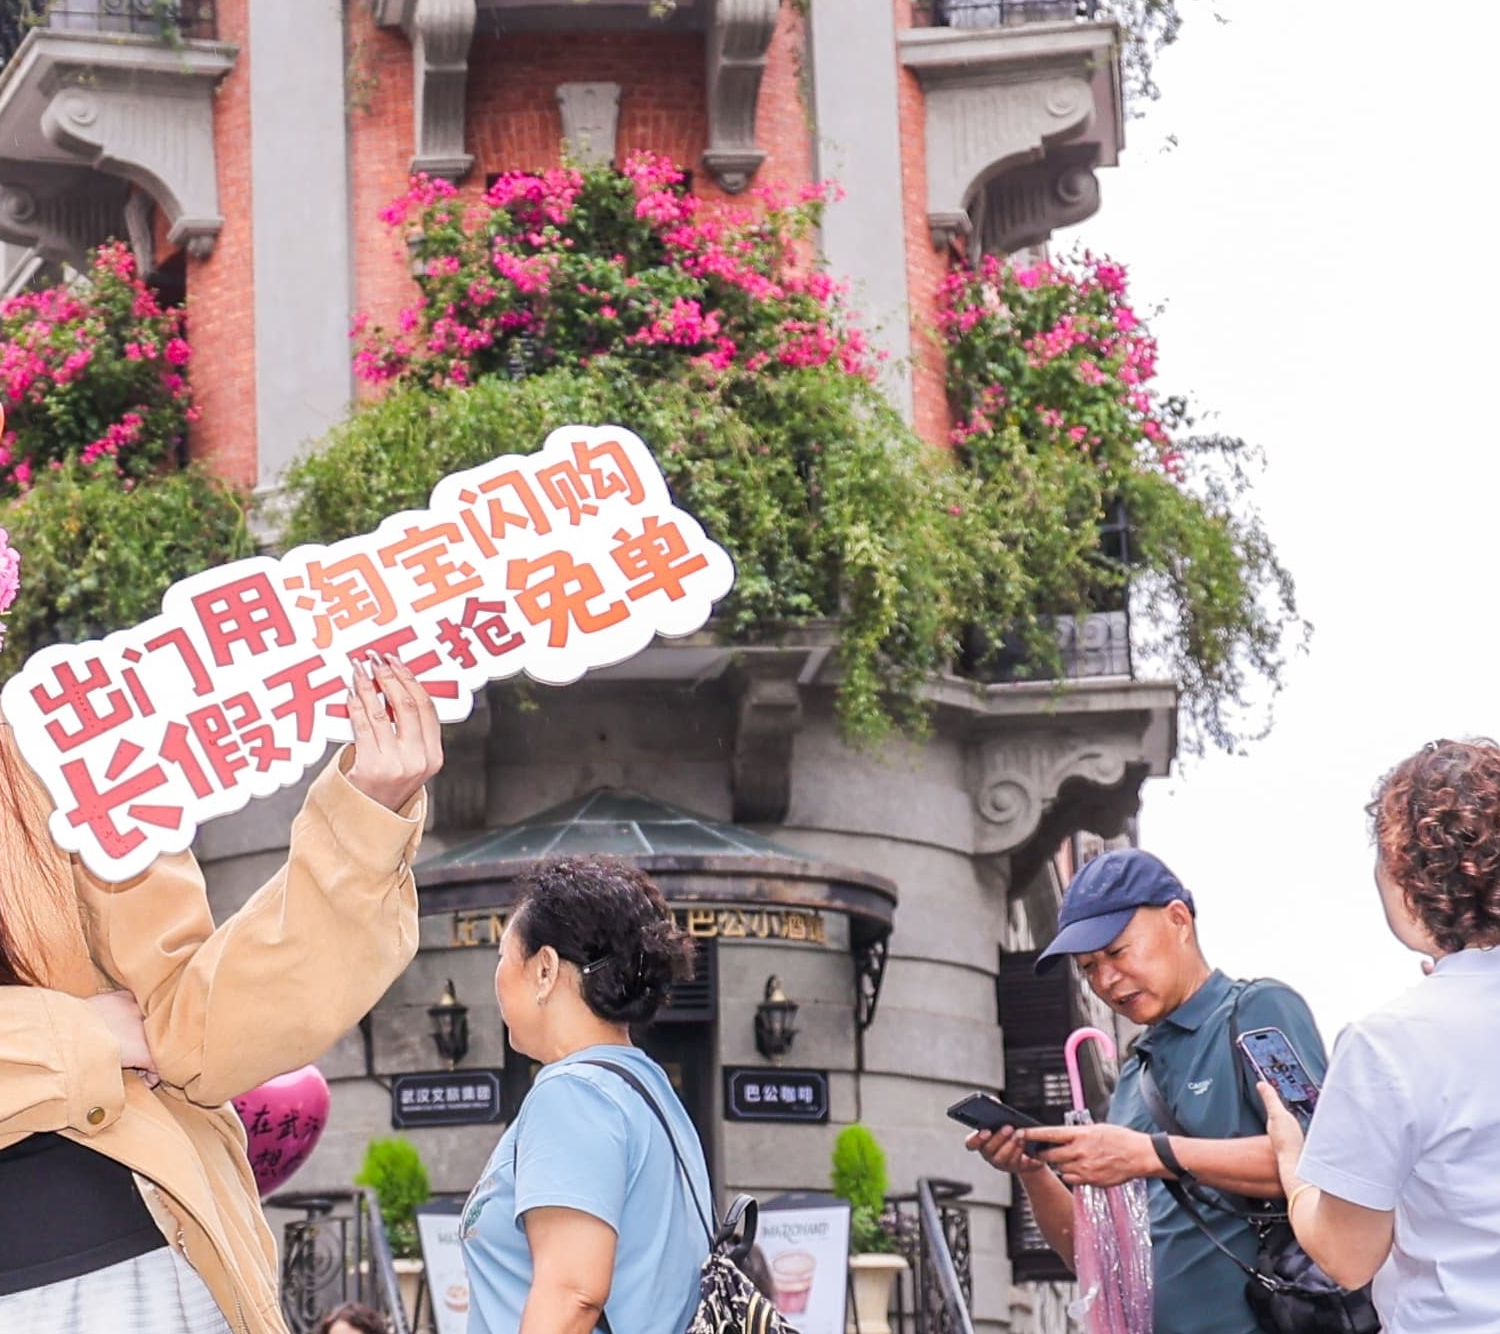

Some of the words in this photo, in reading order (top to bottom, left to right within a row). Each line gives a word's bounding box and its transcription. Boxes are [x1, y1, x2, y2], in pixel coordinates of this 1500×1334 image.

[30, 440, 646, 753] 出门用淘宝闪购
[233, 1100, 320, 1141] 在武汉
